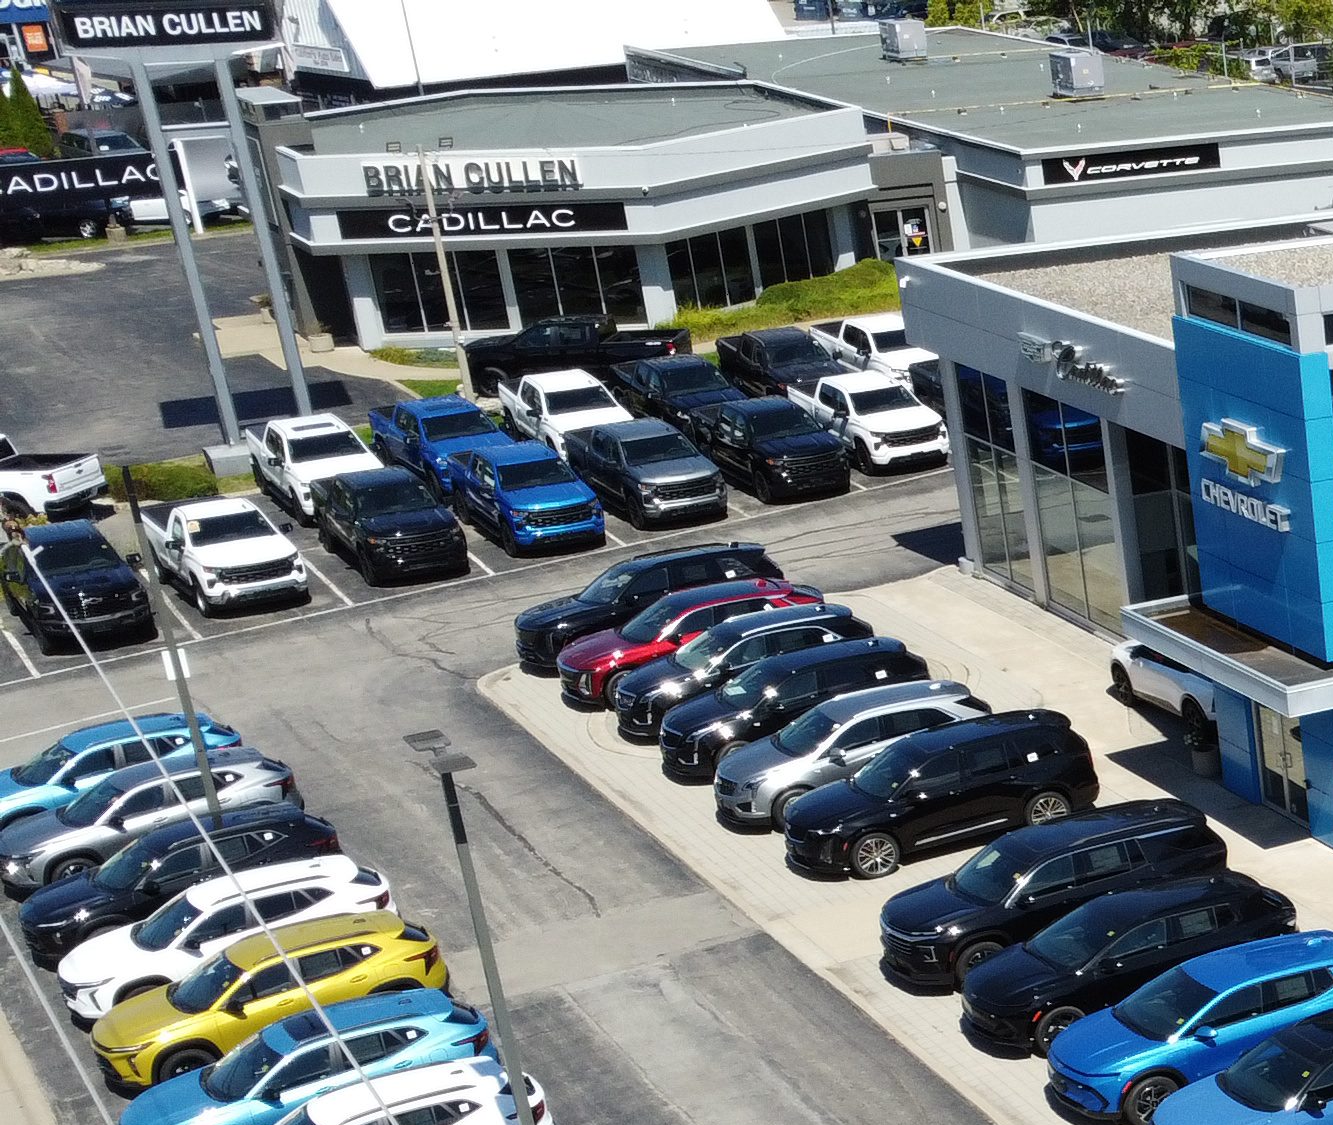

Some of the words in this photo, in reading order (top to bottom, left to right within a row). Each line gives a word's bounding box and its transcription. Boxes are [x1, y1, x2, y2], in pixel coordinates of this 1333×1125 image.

[74, 15, 156, 38] BRIAN
[162, 10, 262, 35] CULLEN
[0, 163, 160, 195] ADILLAC
[363, 163, 455, 195] BRIAN
[464, 160, 582, 193] CULLEN
[1087, 157, 1199, 174] CORVETTE
[388, 209, 576, 232] CADILLAC
[1201, 478, 1291, 532] CHEVROLET
